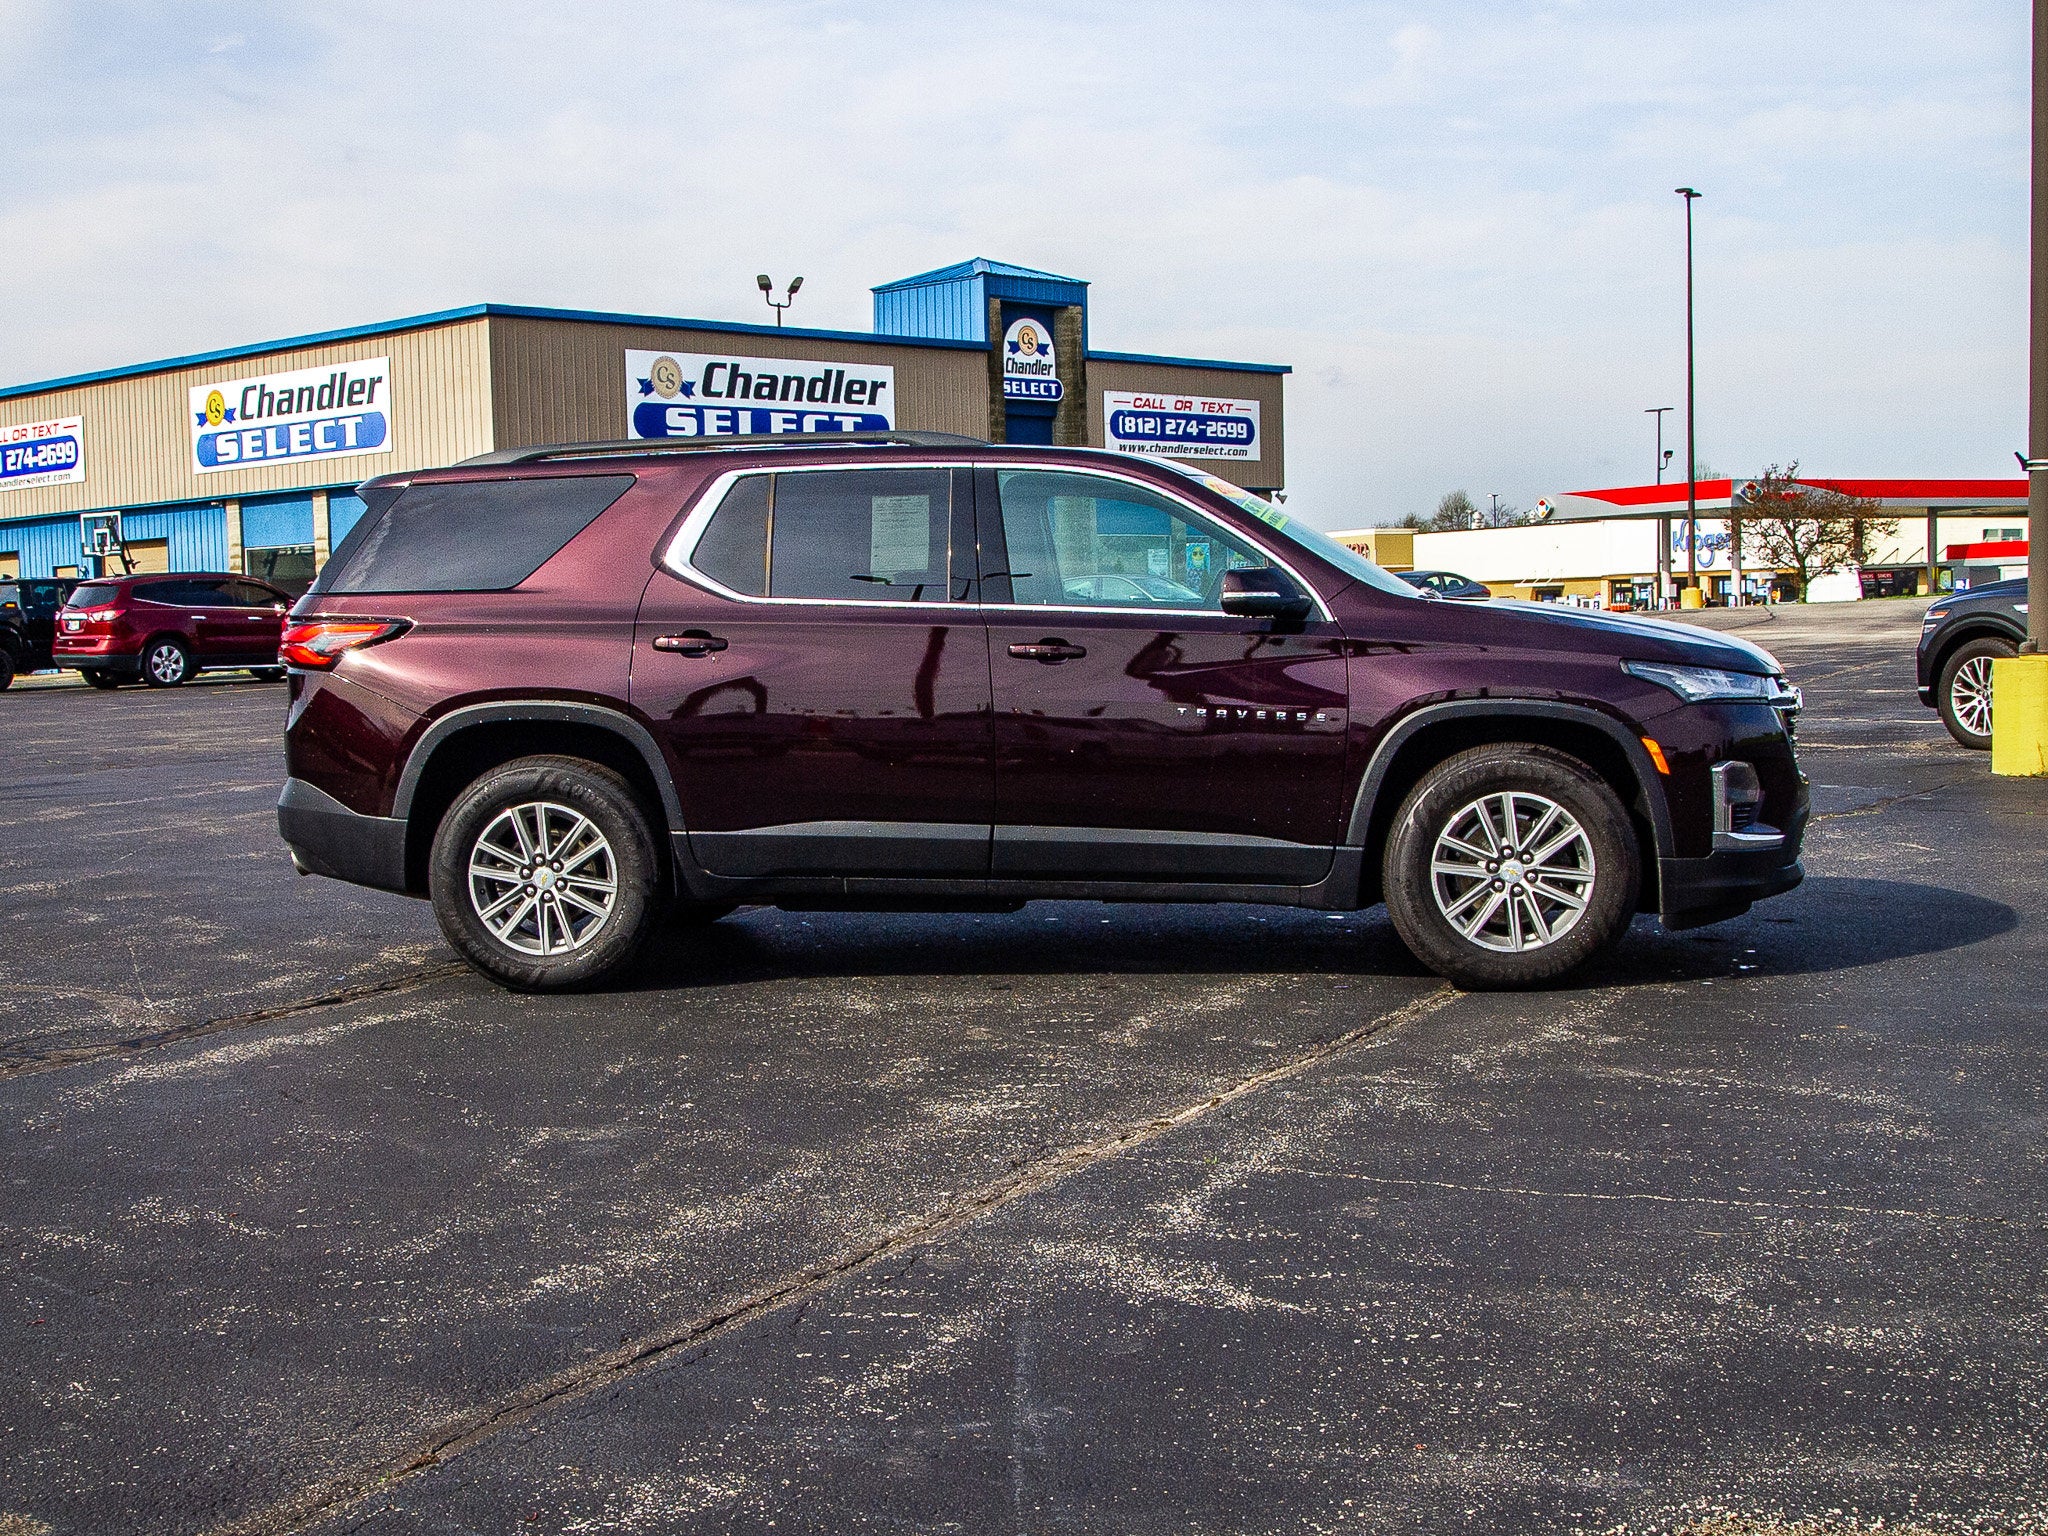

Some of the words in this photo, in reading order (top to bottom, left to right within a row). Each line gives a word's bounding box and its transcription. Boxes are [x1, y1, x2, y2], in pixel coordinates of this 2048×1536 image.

[1005, 357, 1053, 376] Chandler
[701, 362, 887, 406] Chandler
[1004, 380, 1058, 396] SELECT
[240, 372, 383, 421] Chandler
[1133, 397, 1166, 410] CALL
[1174, 400, 1193, 412] OR
[1200, 402, 1234, 414] TEXT
[12, 428, 28, 441] OR
[32, 423, 59, 438] TEXT
[1118, 415, 1161, 436] (812)
[1165, 419, 1248, 439] 274-2699
[214, 416, 363, 463] SELECT
[5, 441, 77, 471] 274-2699
[1119, 443, 1248, 457] www.chandlerselect.com
[1177, 707, 1327, 722] TRAVERSE
